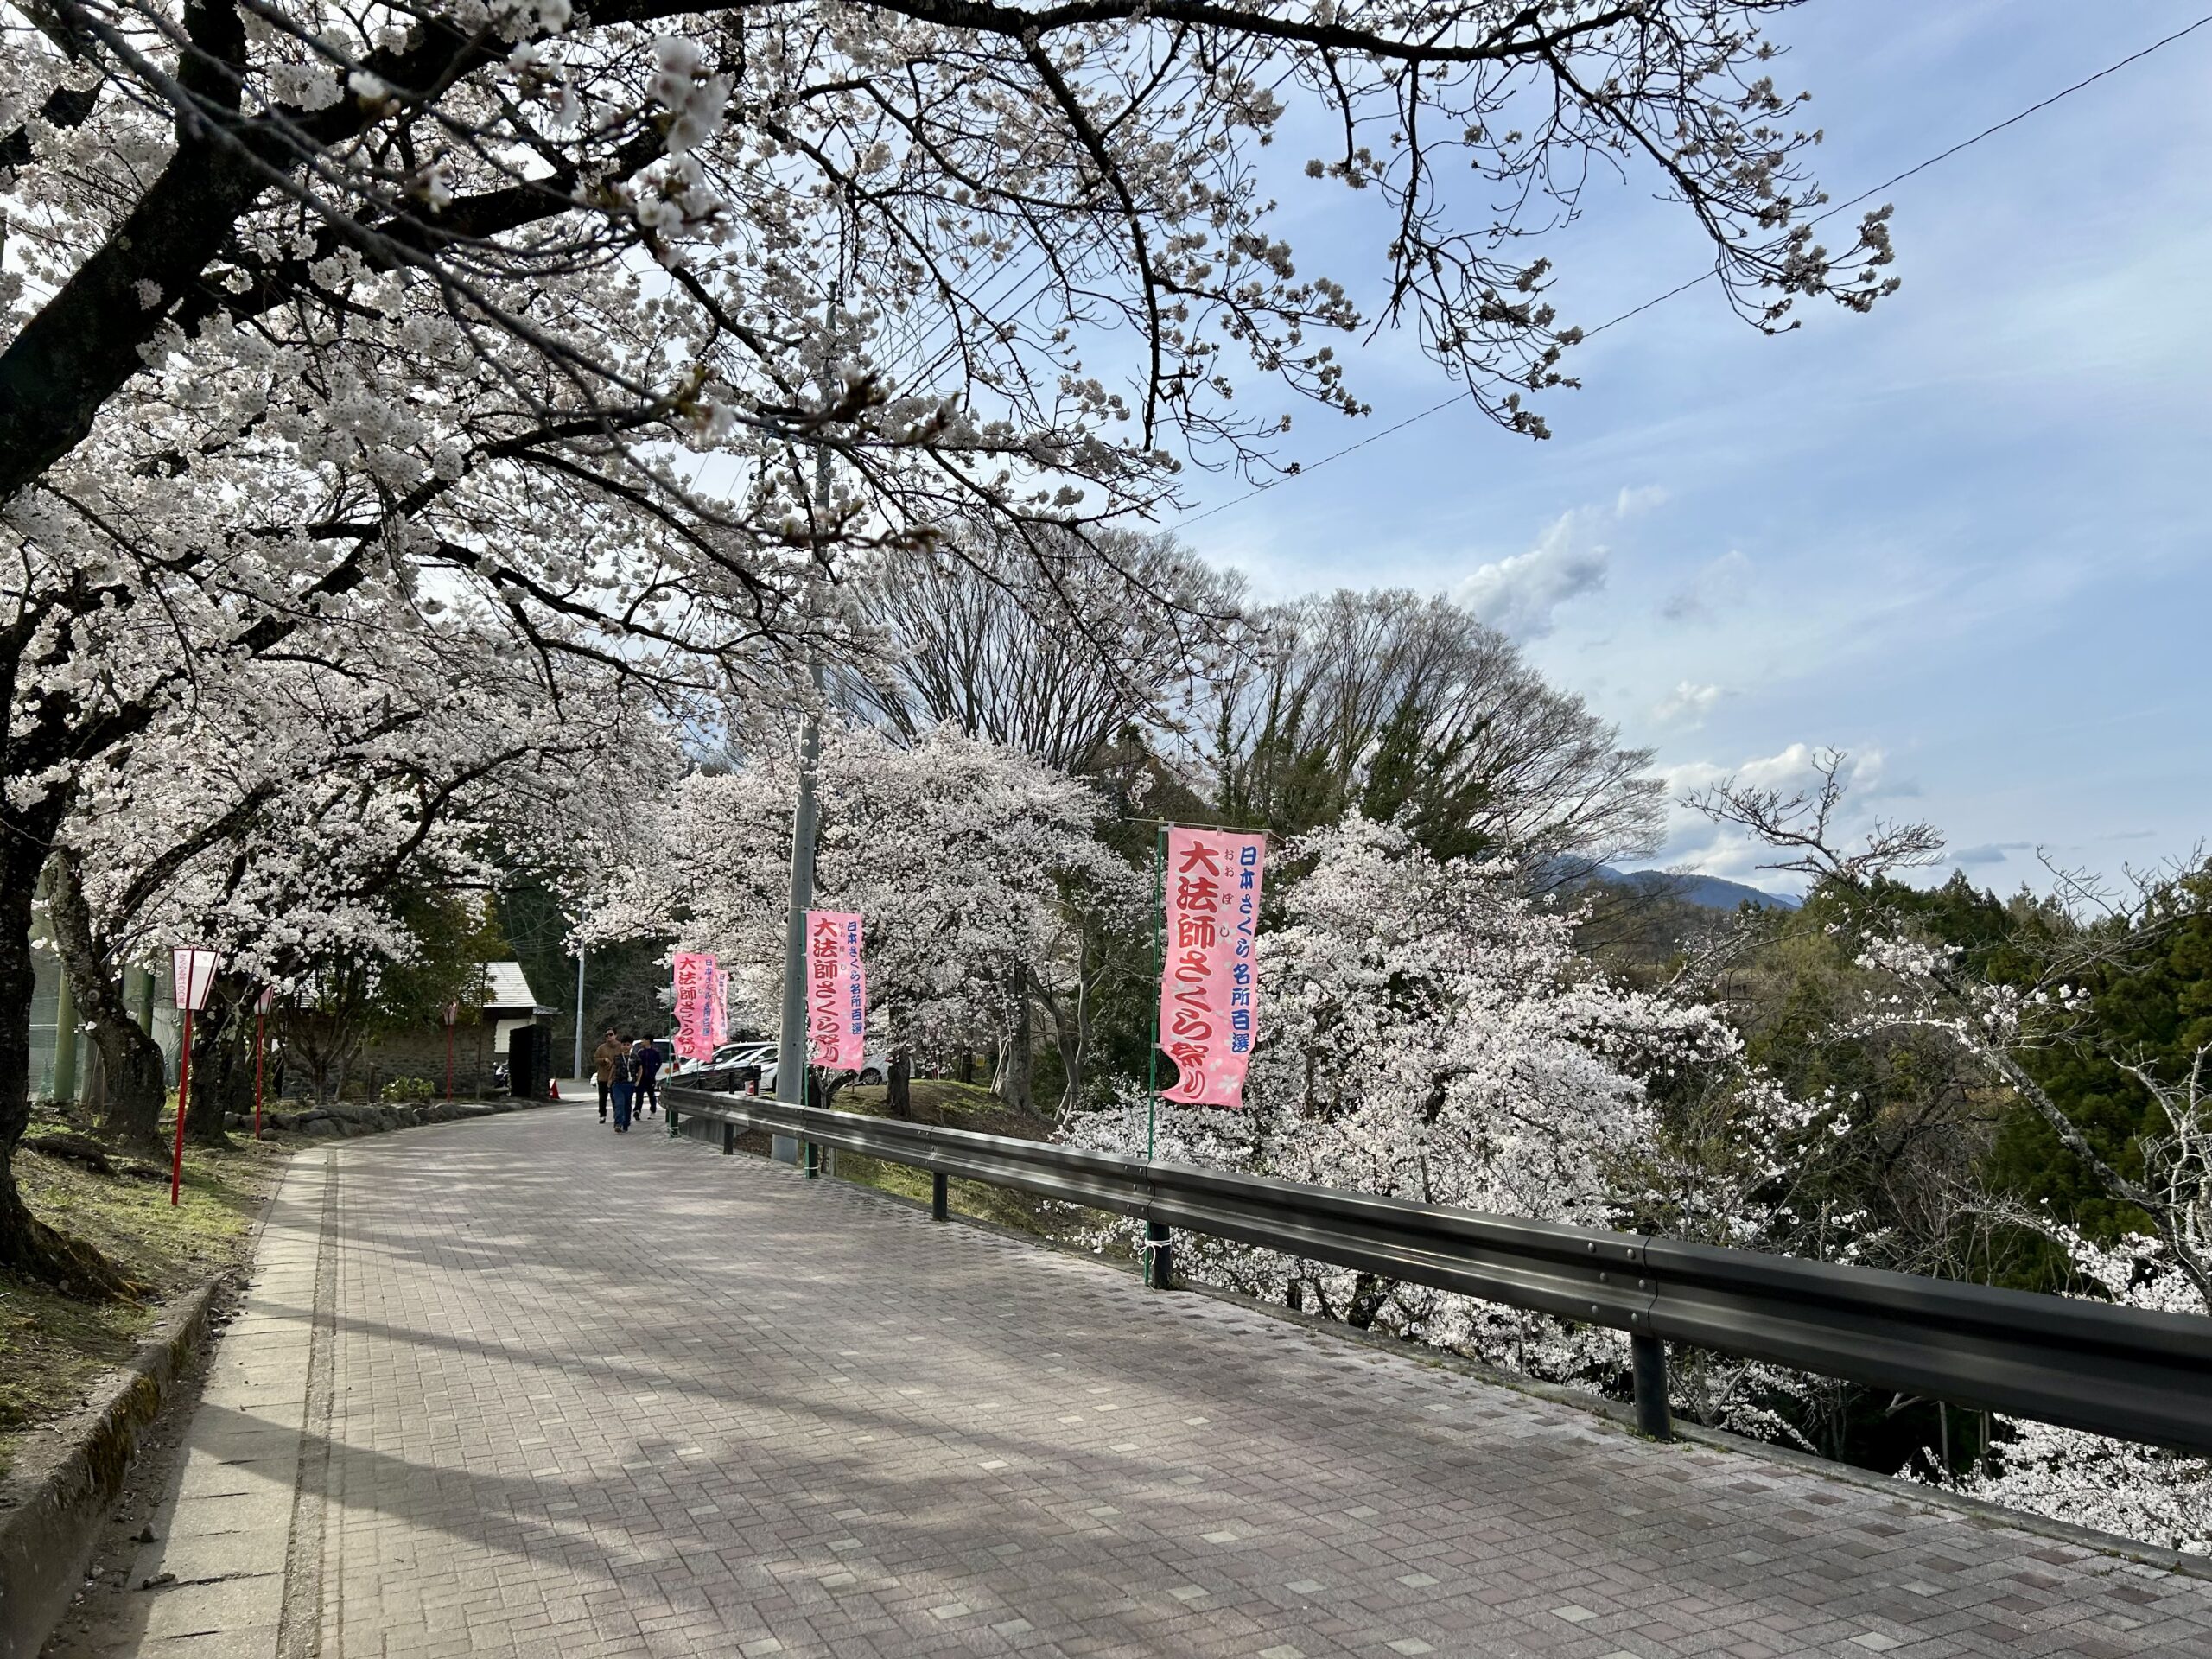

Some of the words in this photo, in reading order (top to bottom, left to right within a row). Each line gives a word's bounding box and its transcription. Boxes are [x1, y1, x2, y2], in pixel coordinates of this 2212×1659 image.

[1170, 841, 1220, 1099] 大法師さくら祭り
[1219, 849, 1235, 938] おおぼし
[1231, 846, 1258, 1053] 日本さくら名所百選
[847, 921, 862, 1035] 日本さくら名所百選
